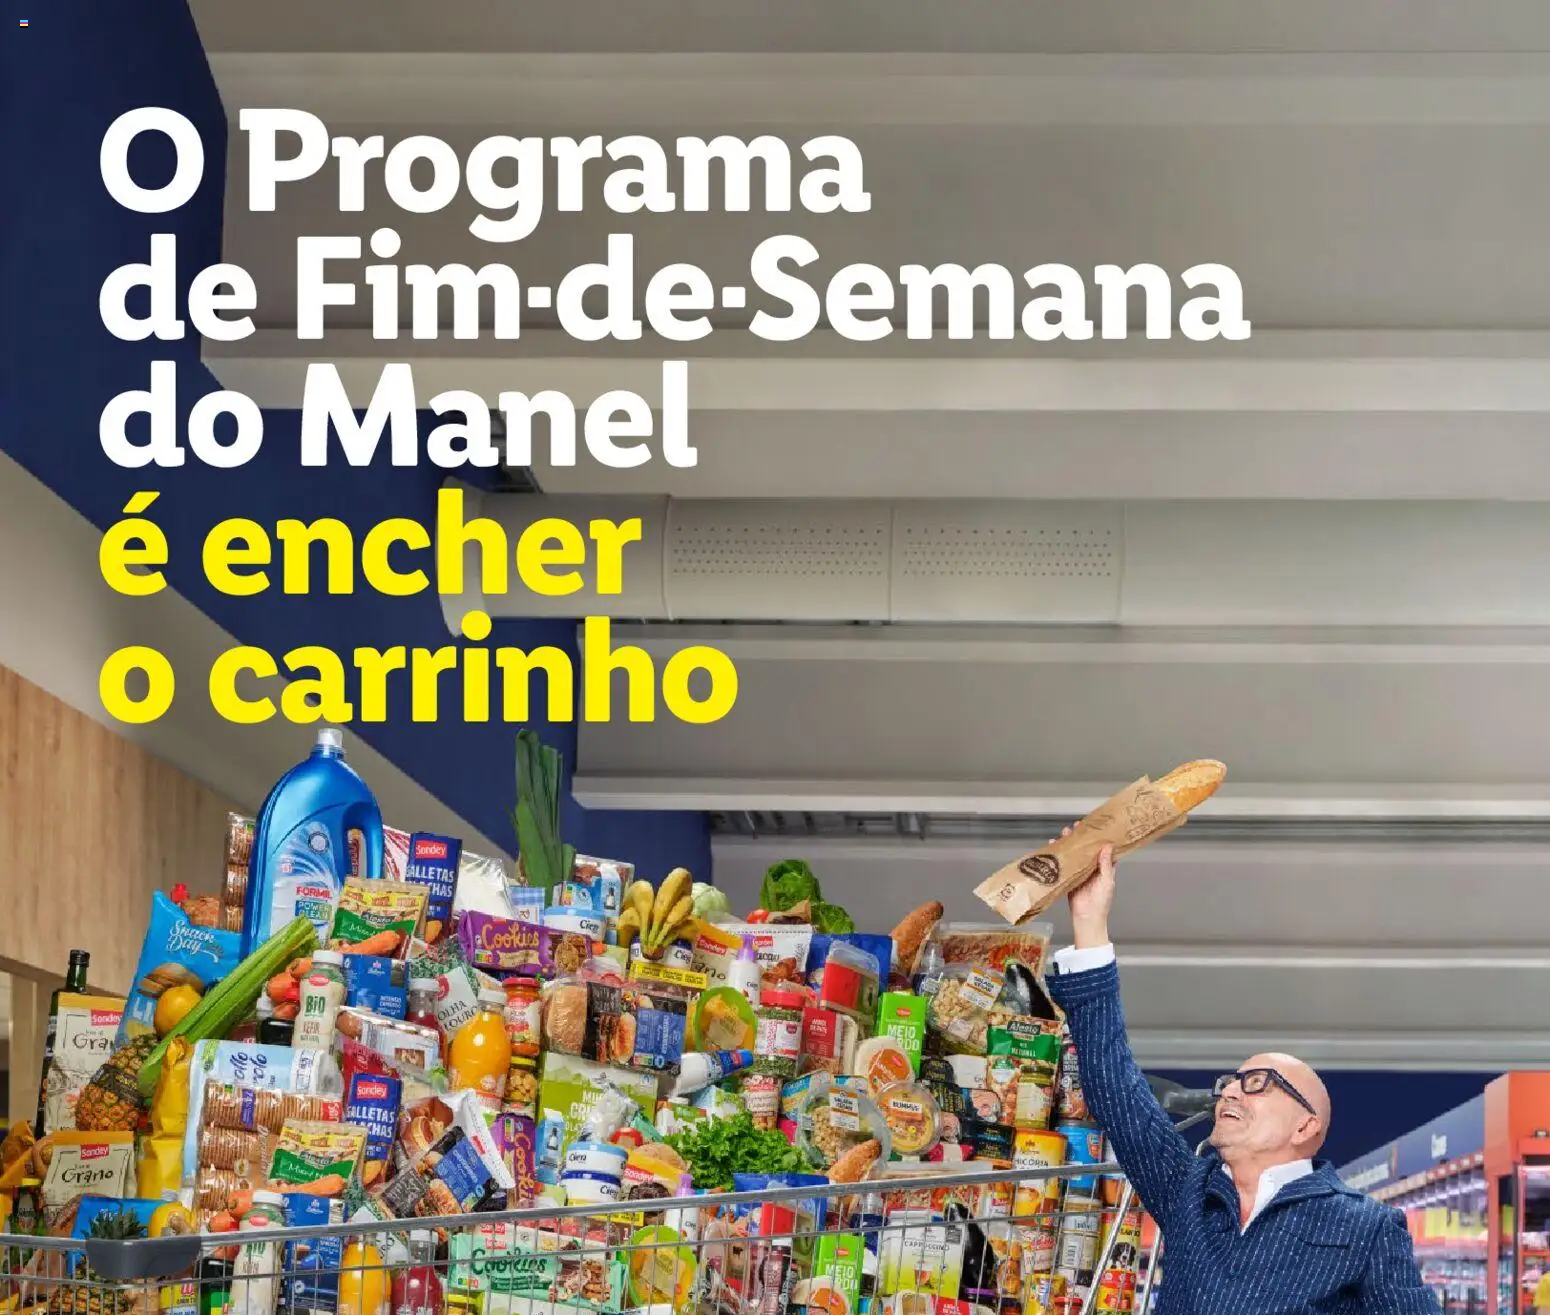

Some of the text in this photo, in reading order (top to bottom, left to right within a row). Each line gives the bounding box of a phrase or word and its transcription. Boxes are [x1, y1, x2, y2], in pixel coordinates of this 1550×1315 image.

[579, 919, 600, 931] Cien
[481, 922, 540, 950] Cookies
[437, 1000, 467, 1022] OLHA
[72, 1033, 118, 1051] Gra
[356, 1084, 388, 1098] Sondey
[81, 1145, 110, 1159] Sondey
[568, 1151, 587, 1162] Cien
[61, 1166, 114, 1184] Grano
